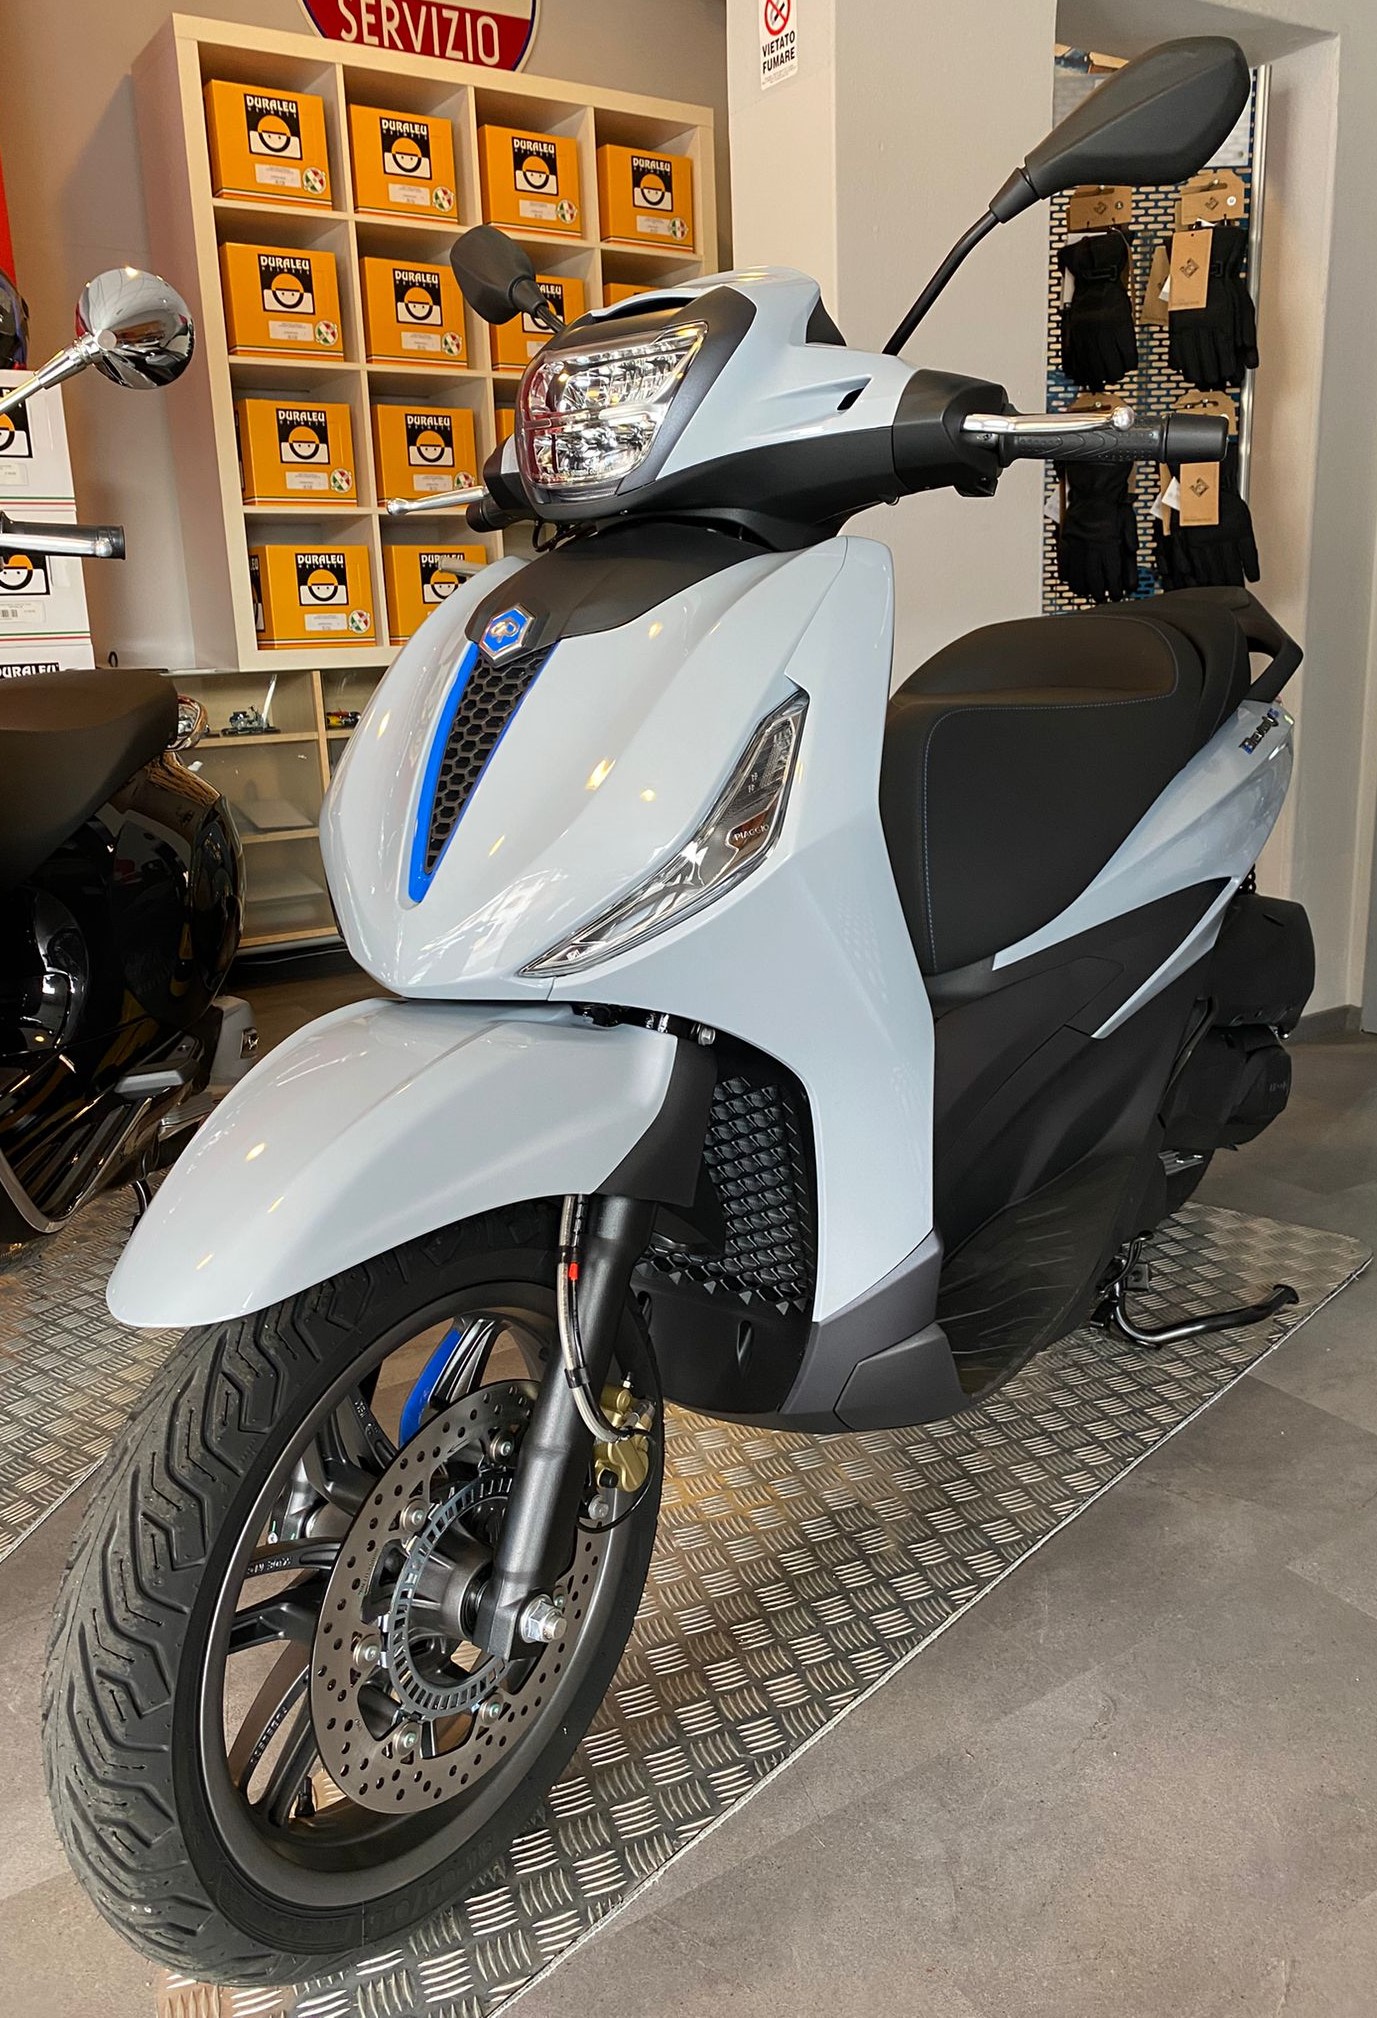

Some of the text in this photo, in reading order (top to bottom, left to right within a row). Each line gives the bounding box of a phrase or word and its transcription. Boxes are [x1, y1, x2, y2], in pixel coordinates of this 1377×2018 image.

[338, 0, 500, 66] SERVIZIO
[762, 31, 796, 57] VIETATO
[762, 47, 796, 74] FUMARE
[246, 95, 296, 113] DURALEU
[381, 119, 428, 135] DURALEU
[513, 138, 555, 153] DURALEU
[632, 157, 671, 171] DURALEU
[260, 255, 309, 270] DURALEU
[395, 270, 438, 284] DURALEU
[278, 410, 325, 422] DURALEU
[407, 415, 450, 426] DURALEU
[297, 554, 344, 565] DURALEU
[0, 664, 57, 678] URALEU
[734, 823, 770, 841] PIAGGIO
